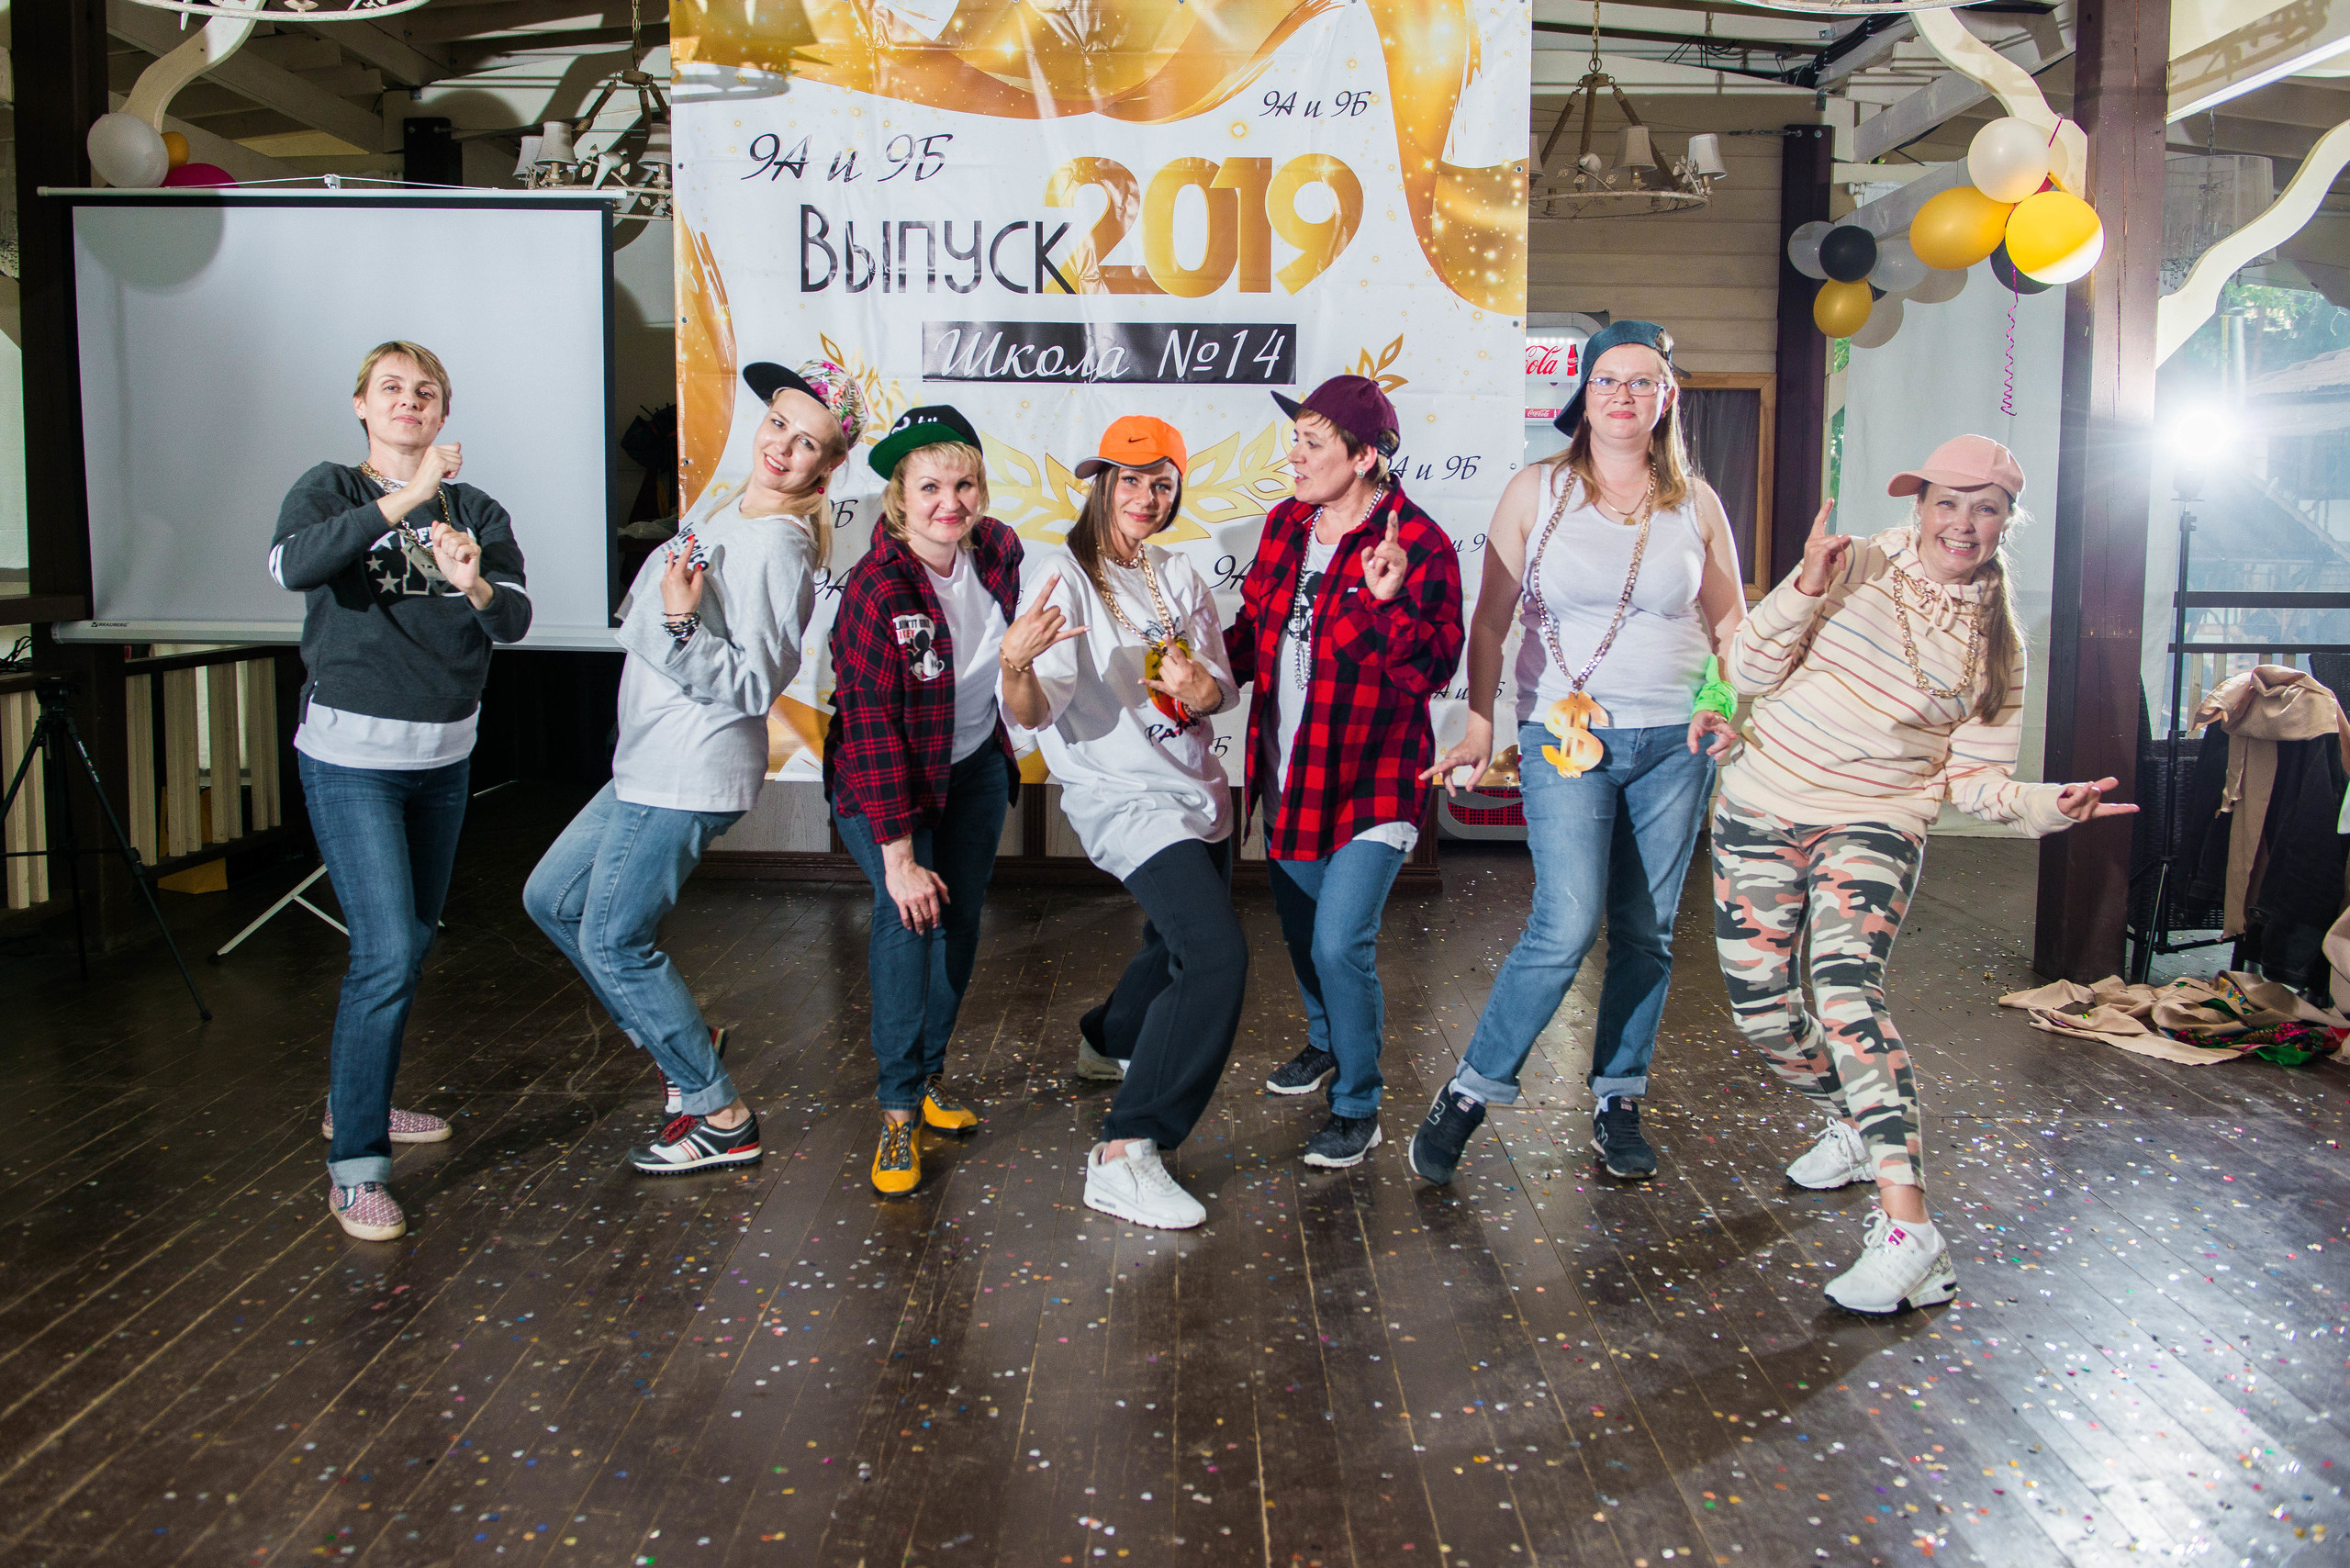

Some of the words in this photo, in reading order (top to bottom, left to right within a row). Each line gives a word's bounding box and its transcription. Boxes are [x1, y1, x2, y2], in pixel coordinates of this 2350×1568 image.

[1259, 90, 1298, 118] 9А
[1304, 100, 1324, 118] и
[1330, 90, 1372, 118] 9Б
[740, 133, 812, 182] 9А
[827, 151, 863, 183] и
[877, 133, 954, 182] 9Б
[1043, 152, 1364, 298] 2019
[933, 328, 1129, 381] Школа
[1158, 329, 1286, 379] №14
[1387, 455, 1410, 478] А
[1415, 464, 1435, 480] и
[1441, 455, 1482, 480] 9Б
[830, 499, 858, 529] Б
[1470, 532, 1488, 553] 9
